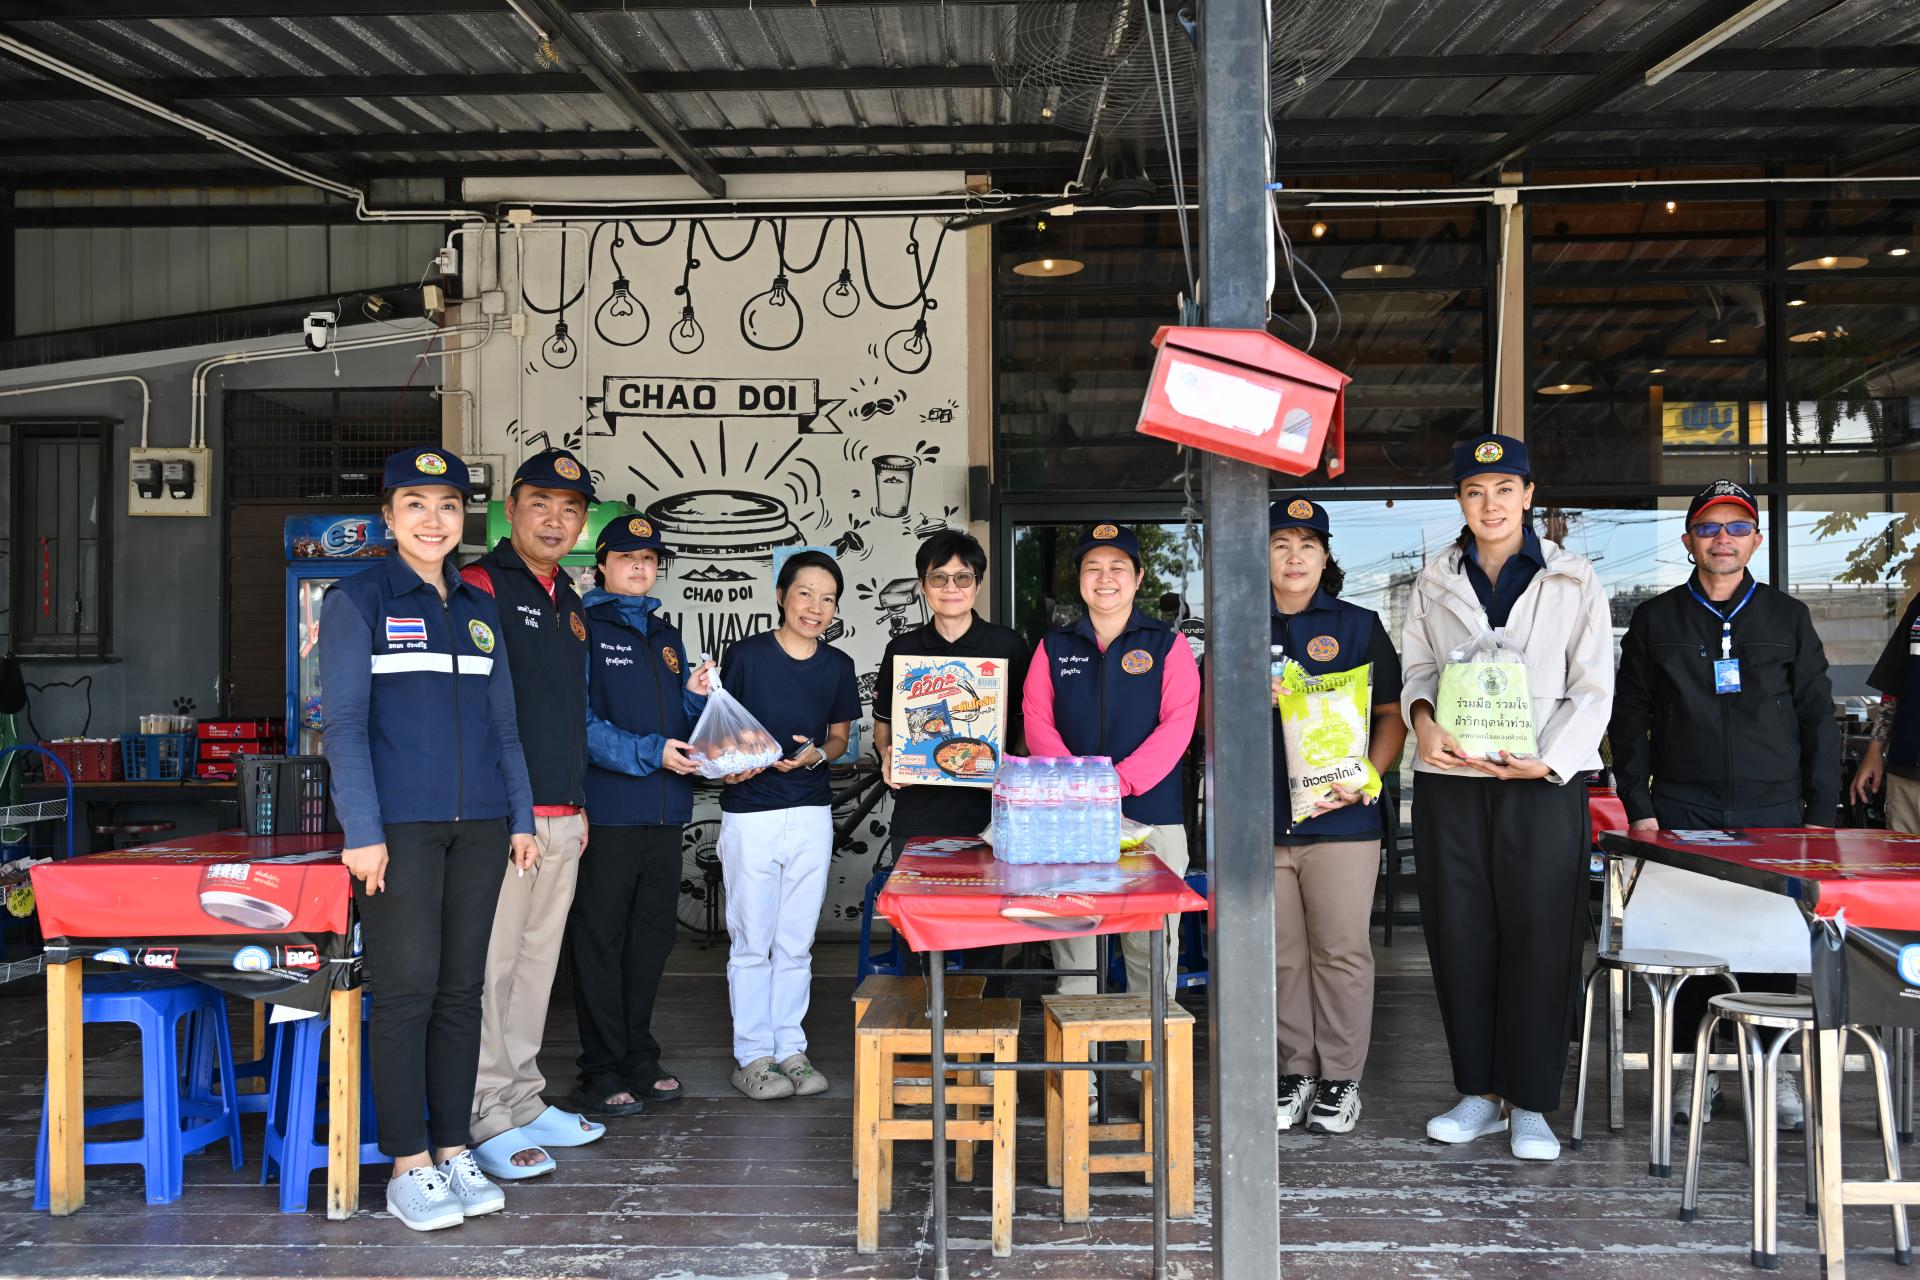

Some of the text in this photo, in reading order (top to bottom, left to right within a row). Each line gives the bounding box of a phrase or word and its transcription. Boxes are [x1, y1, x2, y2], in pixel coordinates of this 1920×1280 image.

[618, 383, 797, 411] CHAO DOI
[327, 523, 366, 547] est
[682, 584, 754, 603] CHAO DOI
[1456, 697, 1529, 710] ร่วมมือ ร่วมใจ
[144, 954, 174, 967] BIG
[286, 951, 318, 966] BIG
